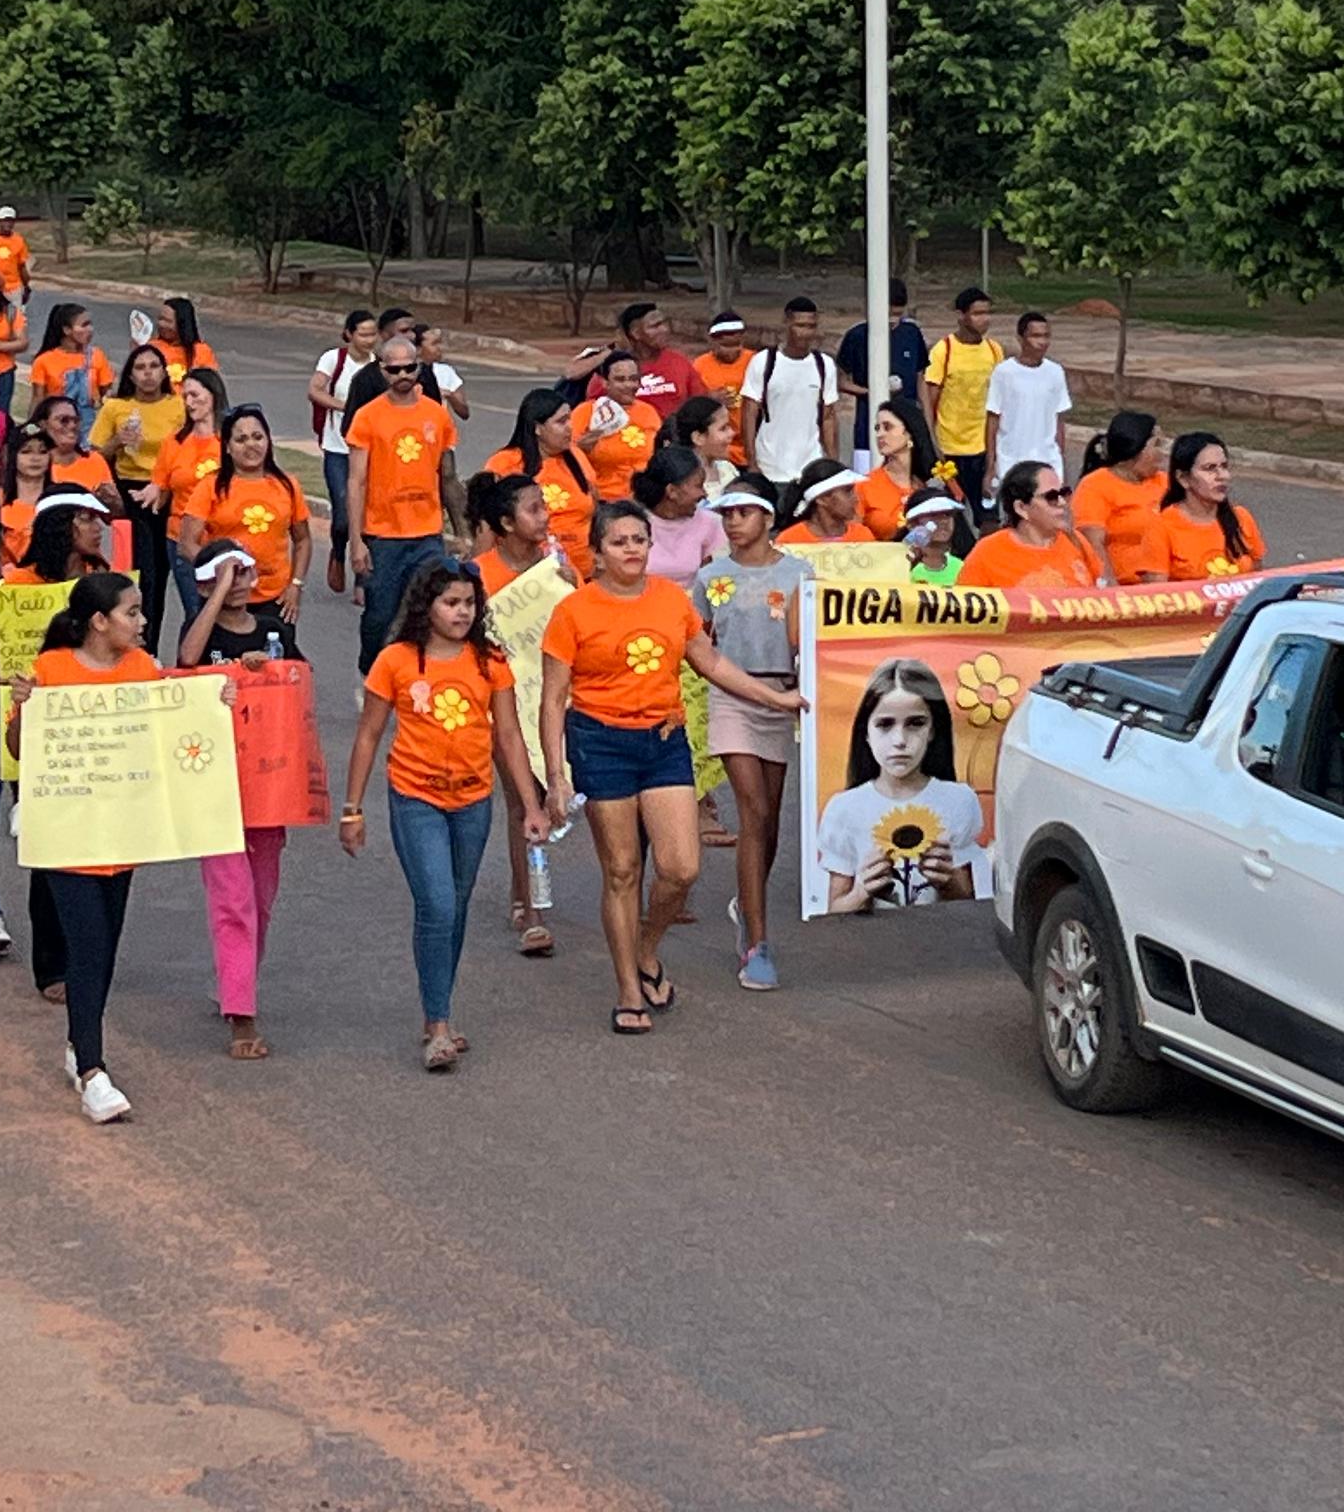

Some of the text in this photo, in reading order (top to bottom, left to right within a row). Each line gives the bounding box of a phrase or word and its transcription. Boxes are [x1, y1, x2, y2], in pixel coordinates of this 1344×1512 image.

[823, 588, 902, 626] DIGA
[1051, 589, 1204, 623] VIOLÊNCIA
[46, 691, 108, 719] FAÇA
